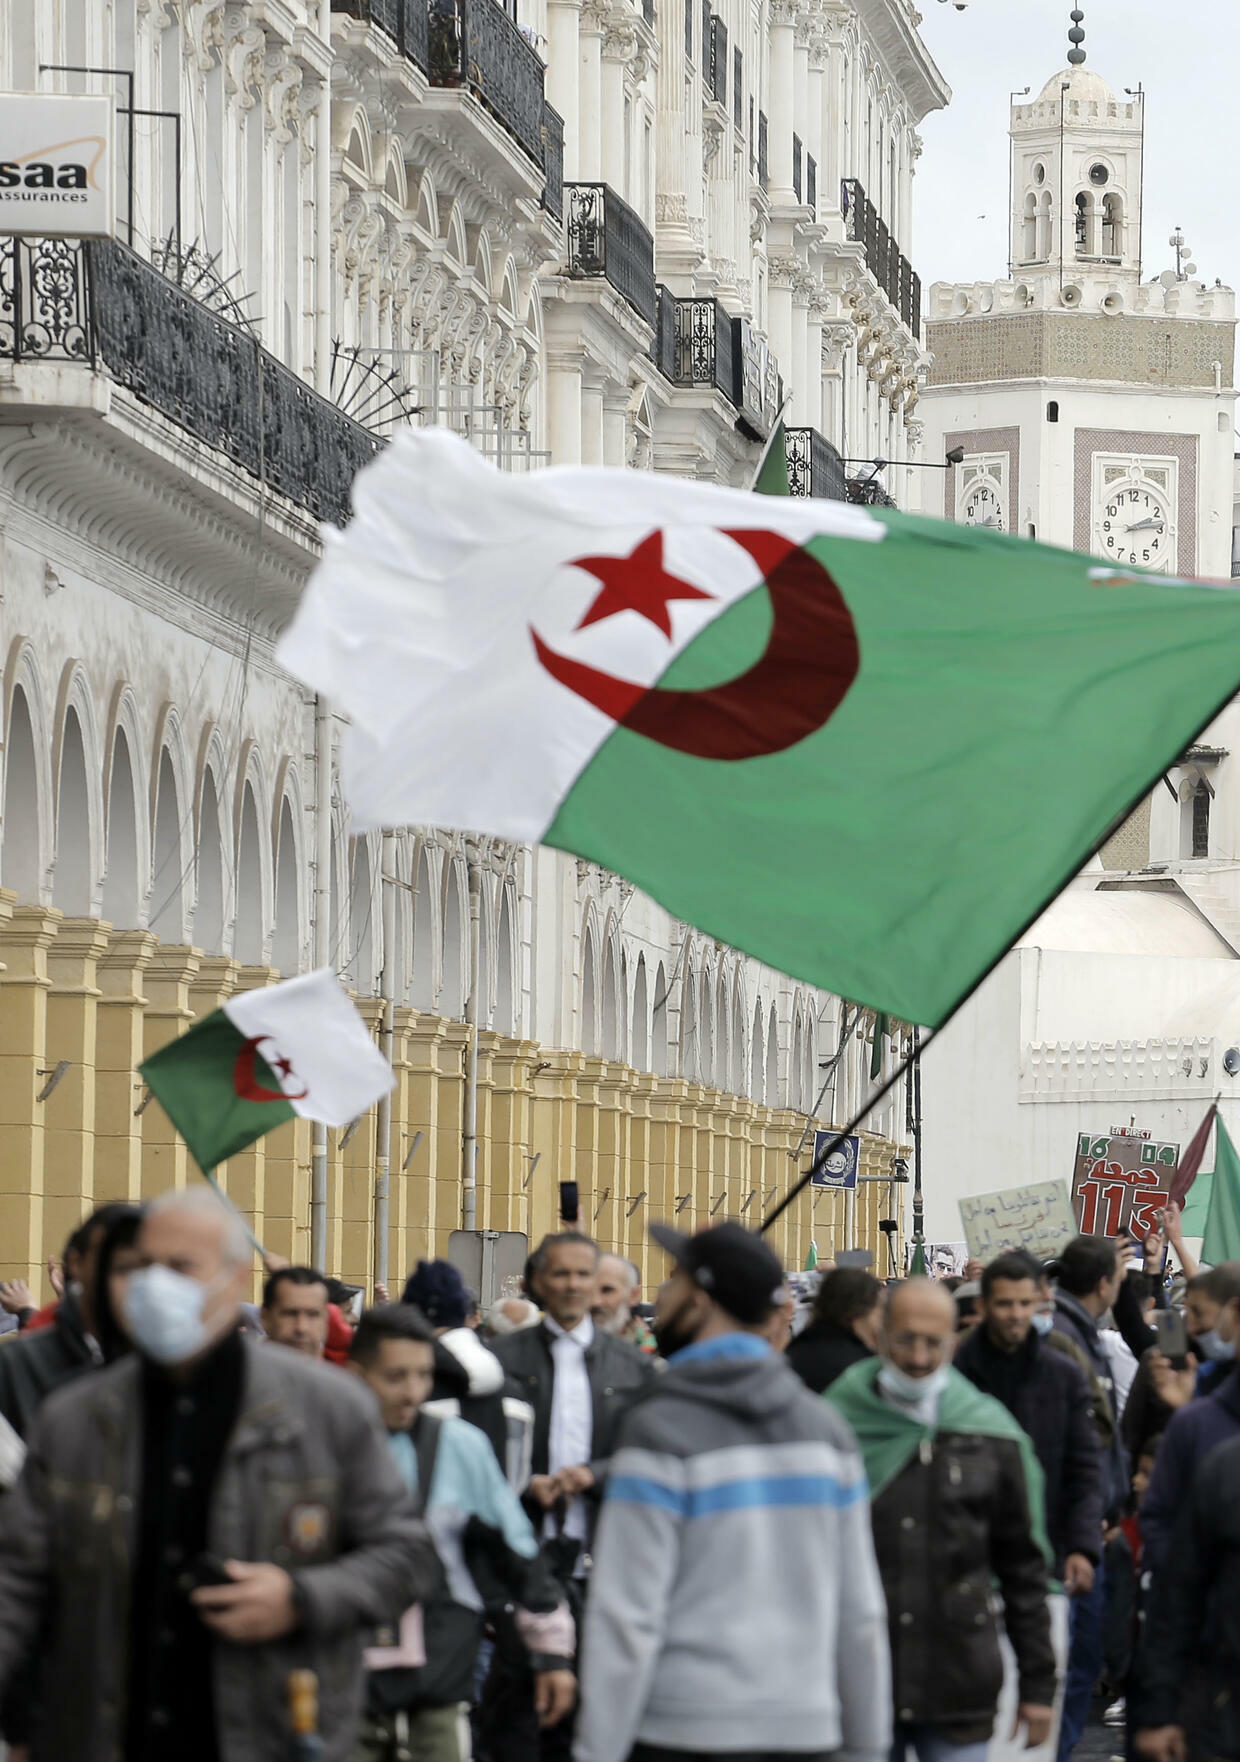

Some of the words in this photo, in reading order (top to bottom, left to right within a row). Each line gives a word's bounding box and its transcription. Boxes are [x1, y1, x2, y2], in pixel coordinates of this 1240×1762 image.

[0, 162, 88, 189] saa
[981, 489, 988, 501] 12
[1116, 494, 1124, 506] 11
[1128, 490, 1139, 502] 12
[1144, 495, 1149, 507] 1
[967, 505, 975, 517] 10
[1105, 505, 1117, 517] 10
[1153, 506, 1161, 518] 2
[1103, 520, 1111, 532] 9
[1106, 536, 1115, 548] 8
[1151, 538, 1159, 550] 4
[1117, 547, 1125, 559] 7
[1129, 552, 1137, 564] 6
[1142, 549, 1150, 561] 5
[1080, 1135, 1112, 1160] 16
[1140, 1142, 1176, 1167] 04
[1077, 1180, 1169, 1242] 113
